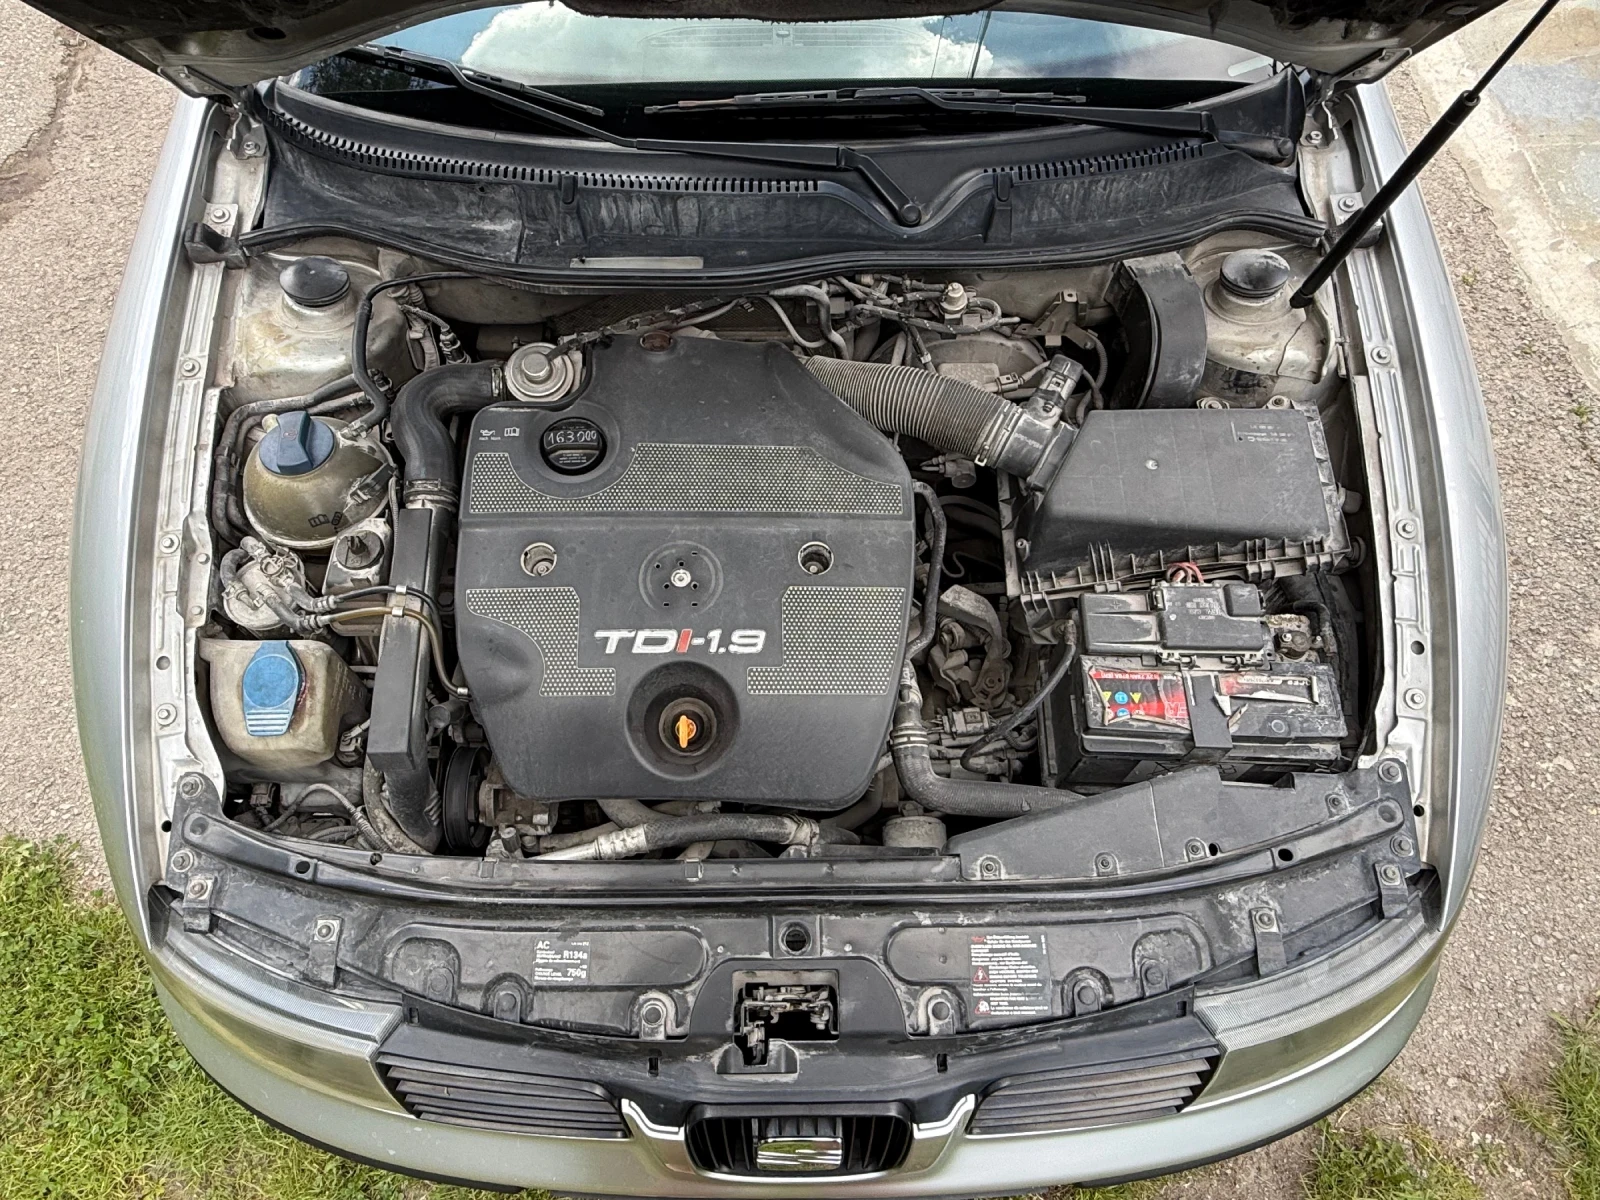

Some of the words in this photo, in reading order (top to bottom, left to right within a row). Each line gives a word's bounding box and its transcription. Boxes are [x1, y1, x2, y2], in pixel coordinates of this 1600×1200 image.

[594, 628, 767, 654] TDI-1.9
[537, 940, 550, 949] AC
[563, 950, 588, 959] R134a
[566, 968, 587, 979] 750g
